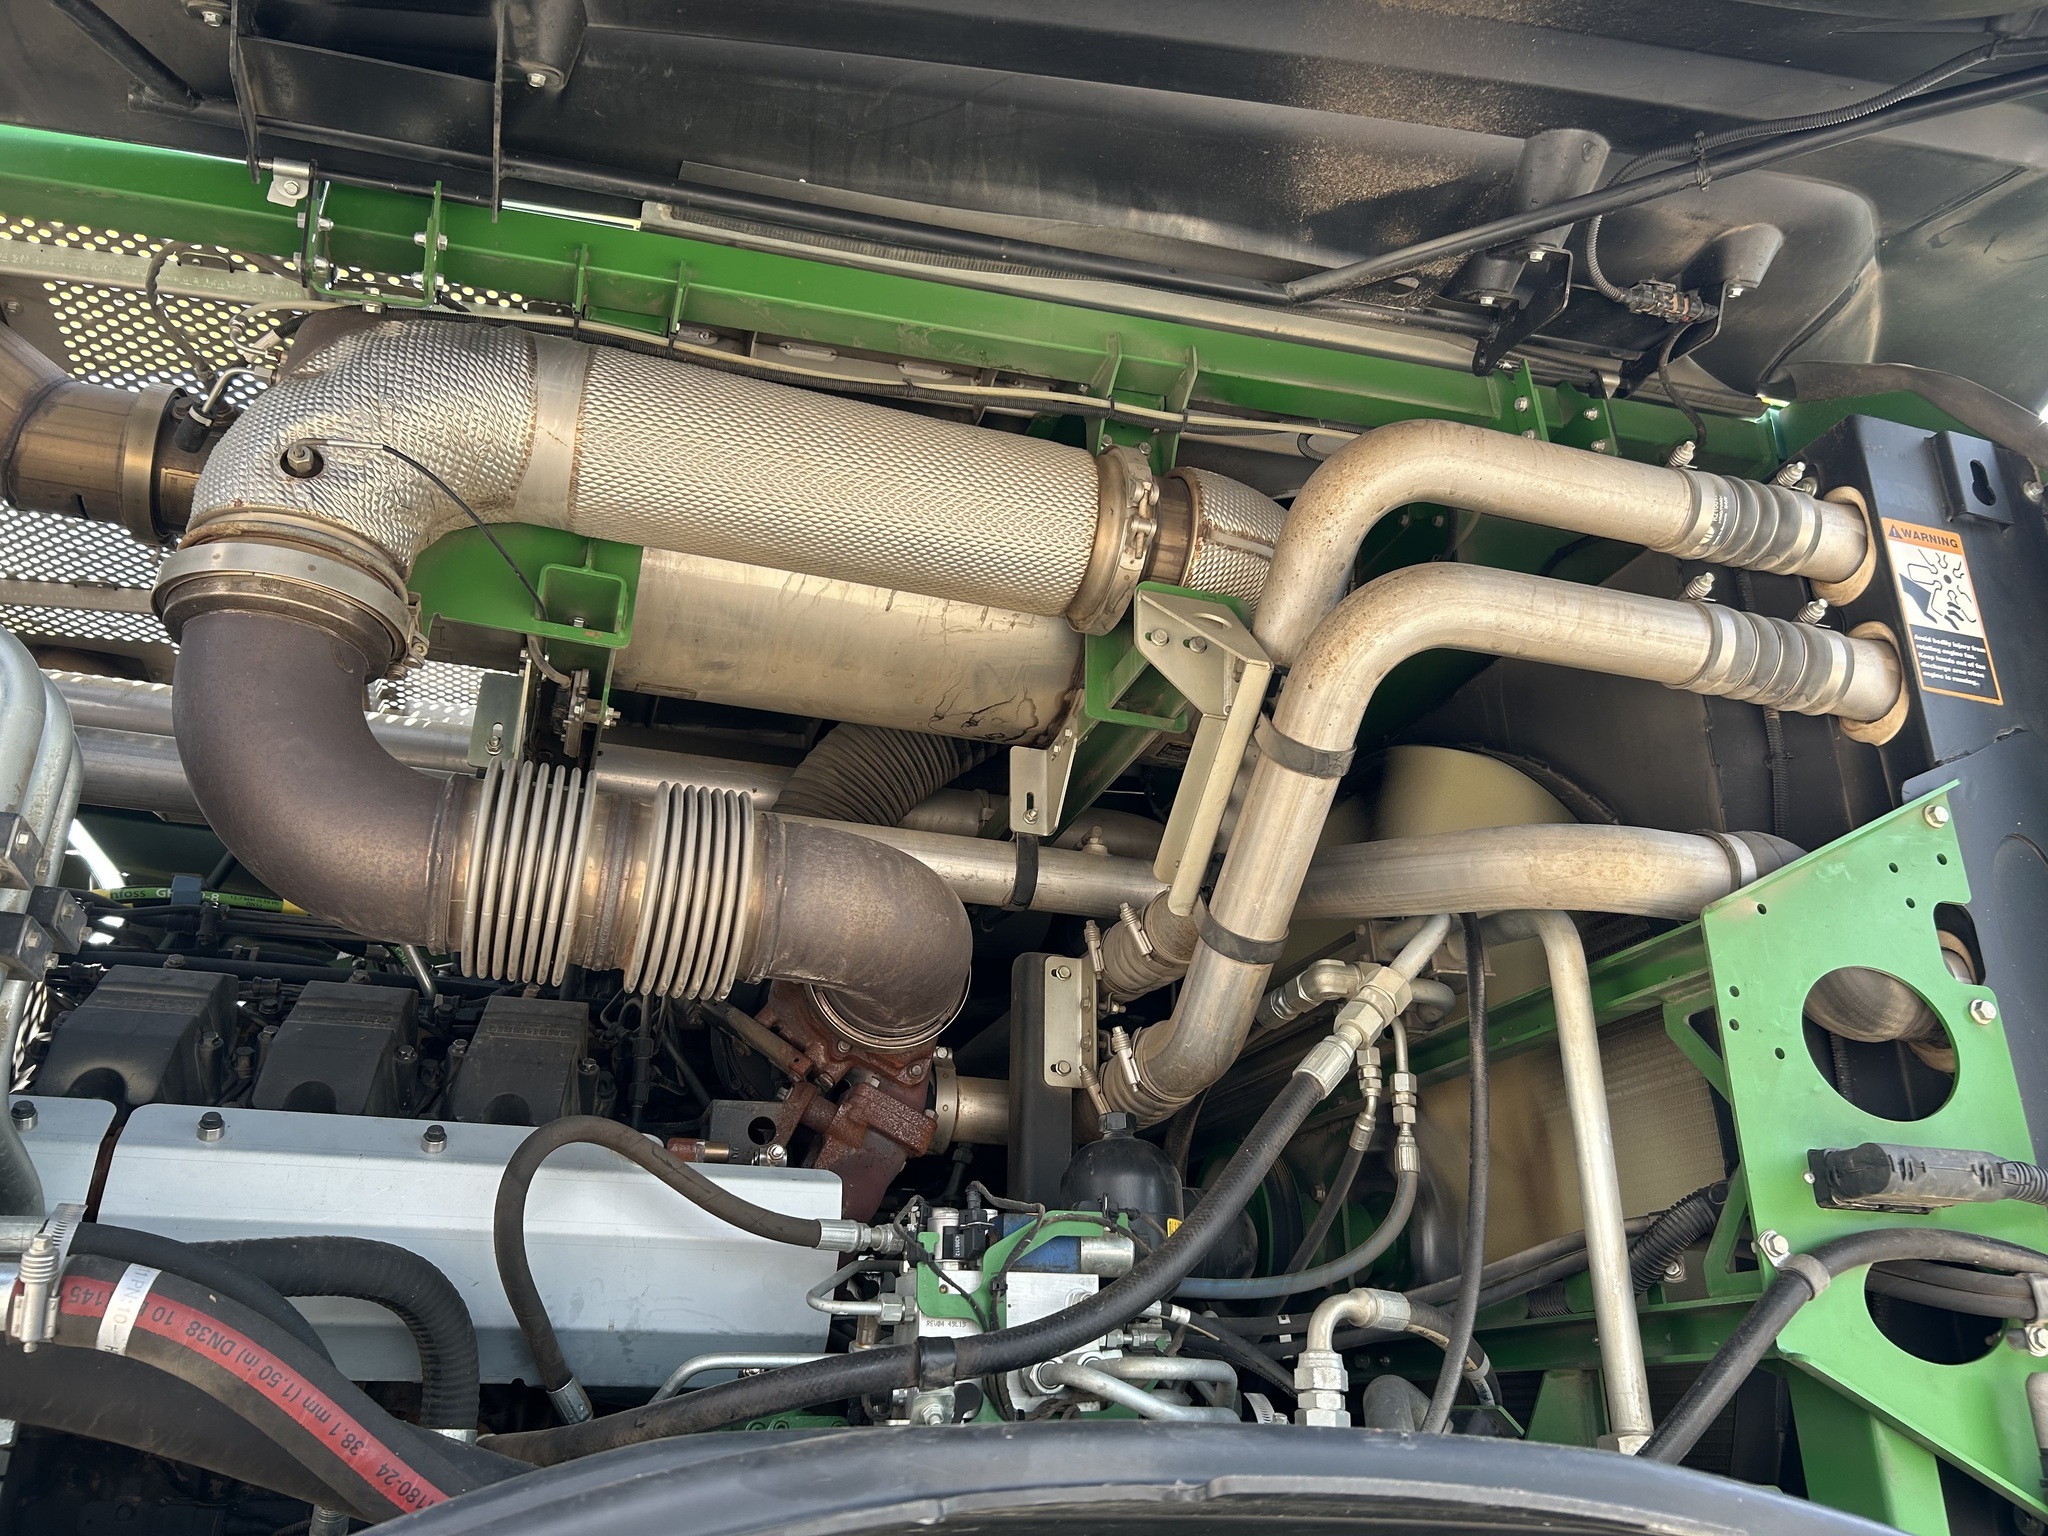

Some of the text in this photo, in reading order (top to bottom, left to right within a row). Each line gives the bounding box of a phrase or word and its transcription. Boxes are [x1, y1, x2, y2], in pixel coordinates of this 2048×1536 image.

[1901, 528, 1959, 548] WARNING
[1916, 644, 1942, 654] rotating
[1942, 649, 1963, 658] engine
[1971, 645, 1986, 653] from
[1918, 652, 1935, 662] Keep
[1935, 655, 1955, 665] hands
[1975, 662, 1986, 671] fan
[1923, 671, 1944, 679] engine
[1967, 670, 1985, 679] when
[151, 1306, 175, 1326] 10
[185, 1320, 237, 1357] DN38
[234, 1347, 260, 1370] in)
[258, 1364, 303, 1404] (1.50
[302, 1396, 331, 1424] mm
[329, 1422, 365, 1456] 38.1
